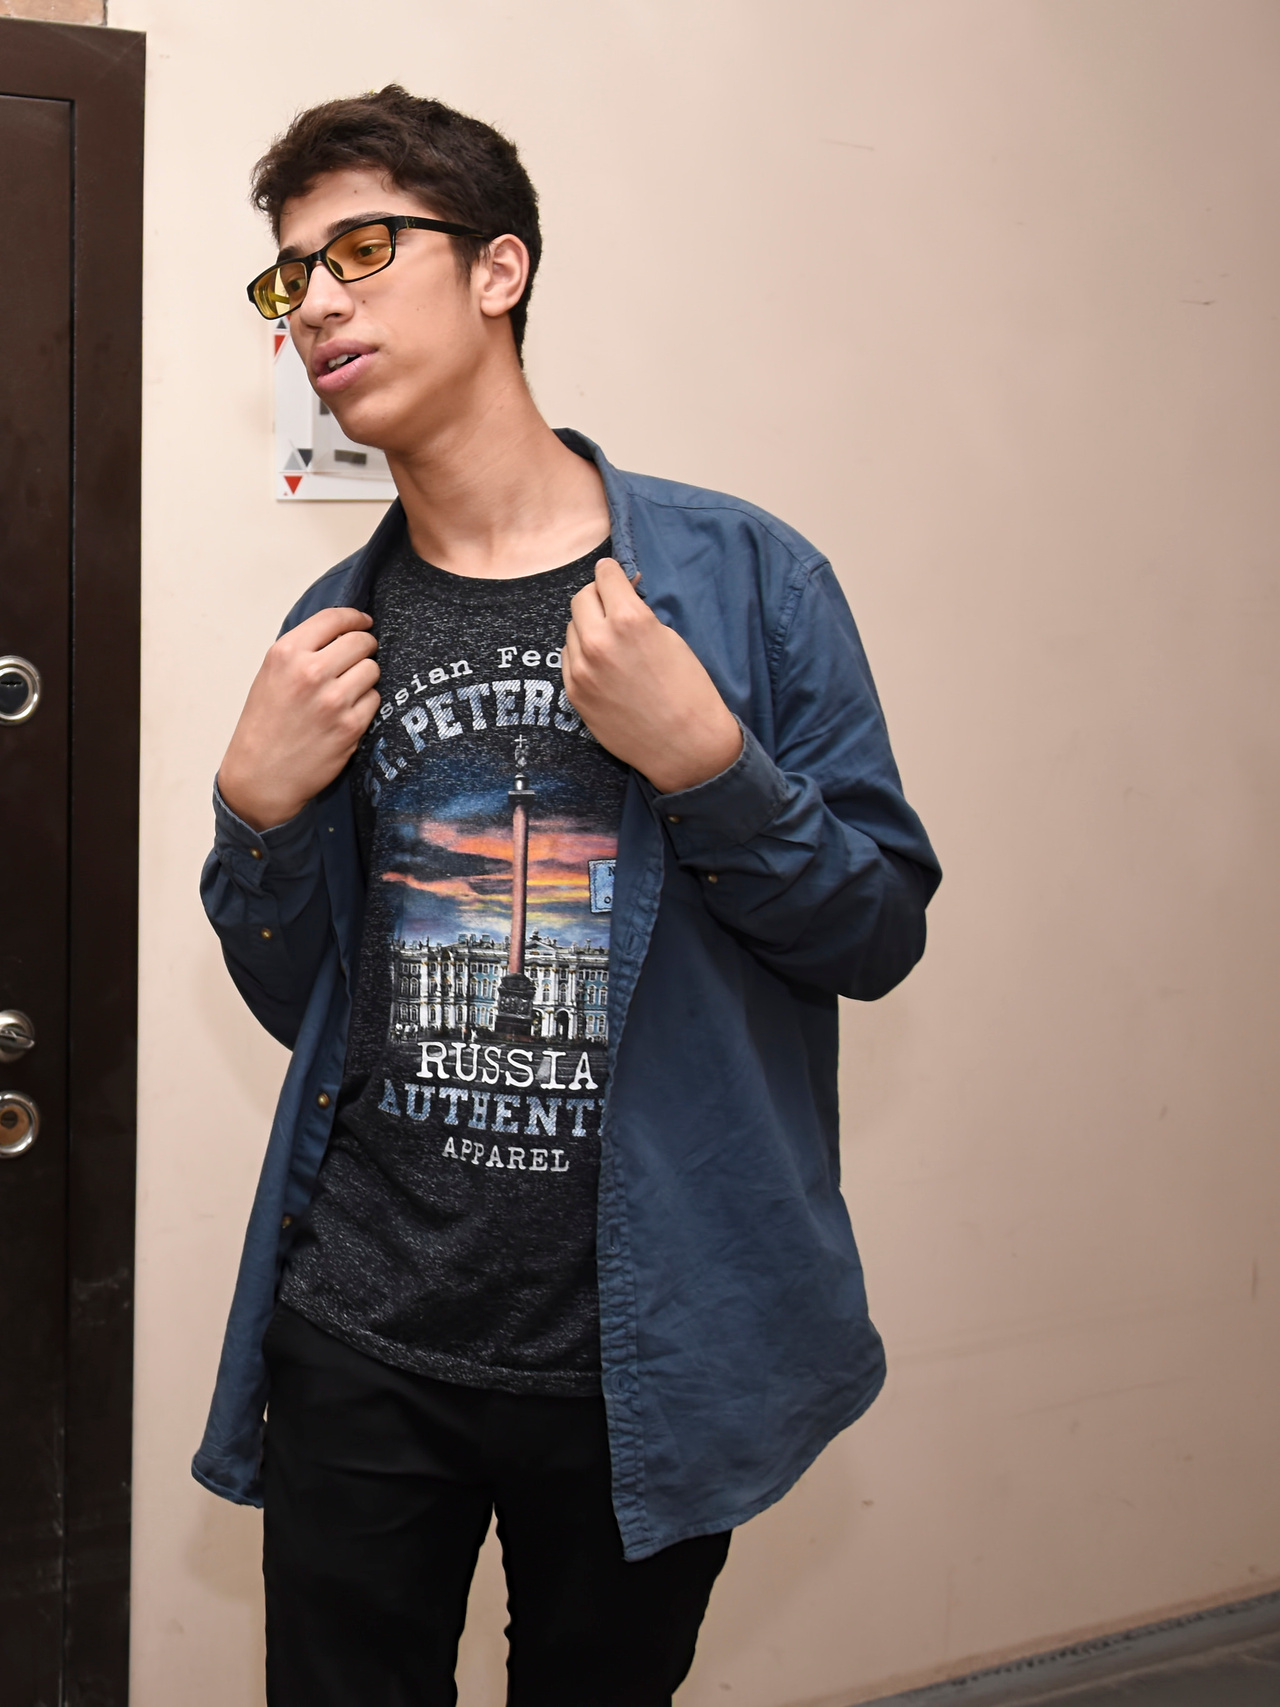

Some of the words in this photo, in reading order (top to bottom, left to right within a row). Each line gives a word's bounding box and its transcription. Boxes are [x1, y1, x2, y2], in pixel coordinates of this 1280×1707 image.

[368, 659, 473, 735] ssian
[497, 646, 563, 669] Fed
[400, 679, 599, 754] PETERS
[416, 1042, 598, 1090] RUSSIA
[377, 1079, 607, 1138] AUTHENT
[441, 1136, 570, 1173] APPAREL
